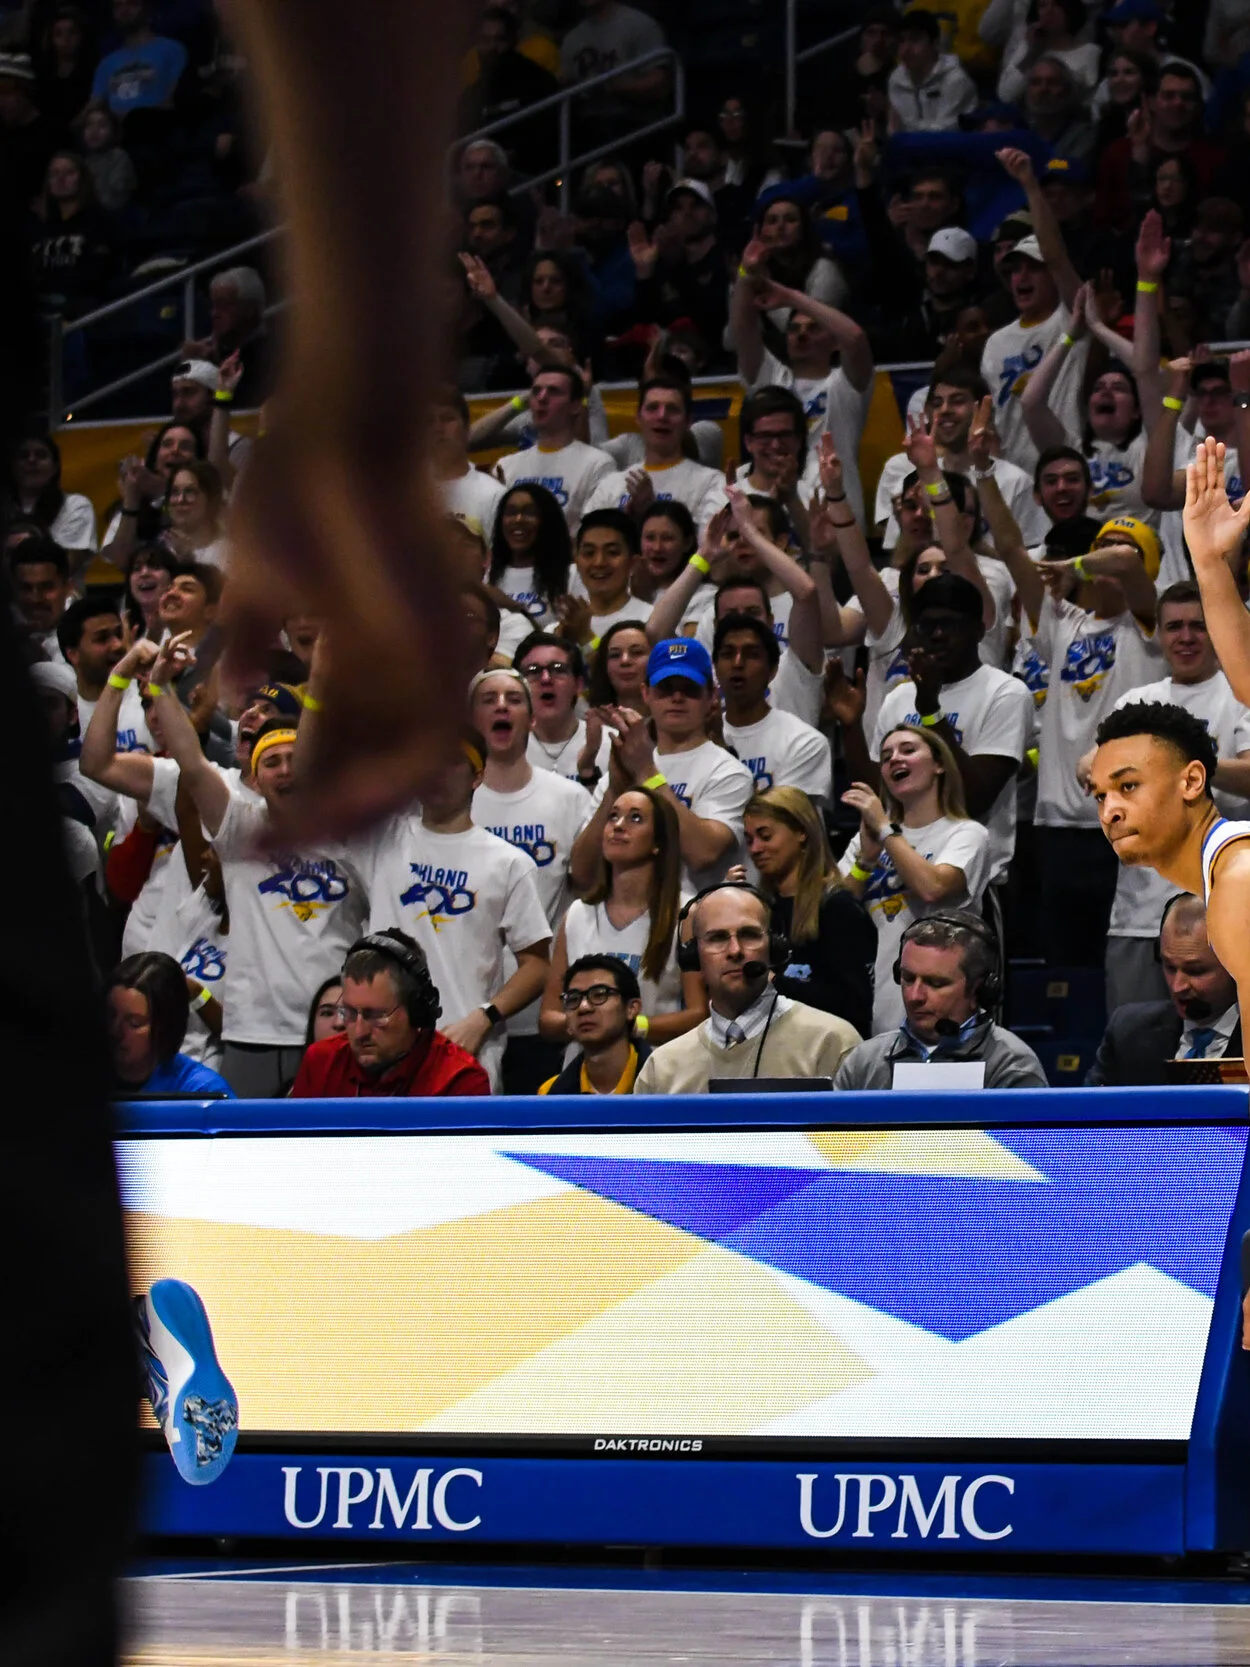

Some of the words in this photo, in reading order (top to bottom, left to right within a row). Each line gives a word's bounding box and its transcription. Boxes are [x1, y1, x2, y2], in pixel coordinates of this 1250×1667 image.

[594, 1439, 703, 1452] DAKTRONICS
[281, 1466, 483, 1532] UPMC
[796, 1473, 1015, 1541] UPMC
